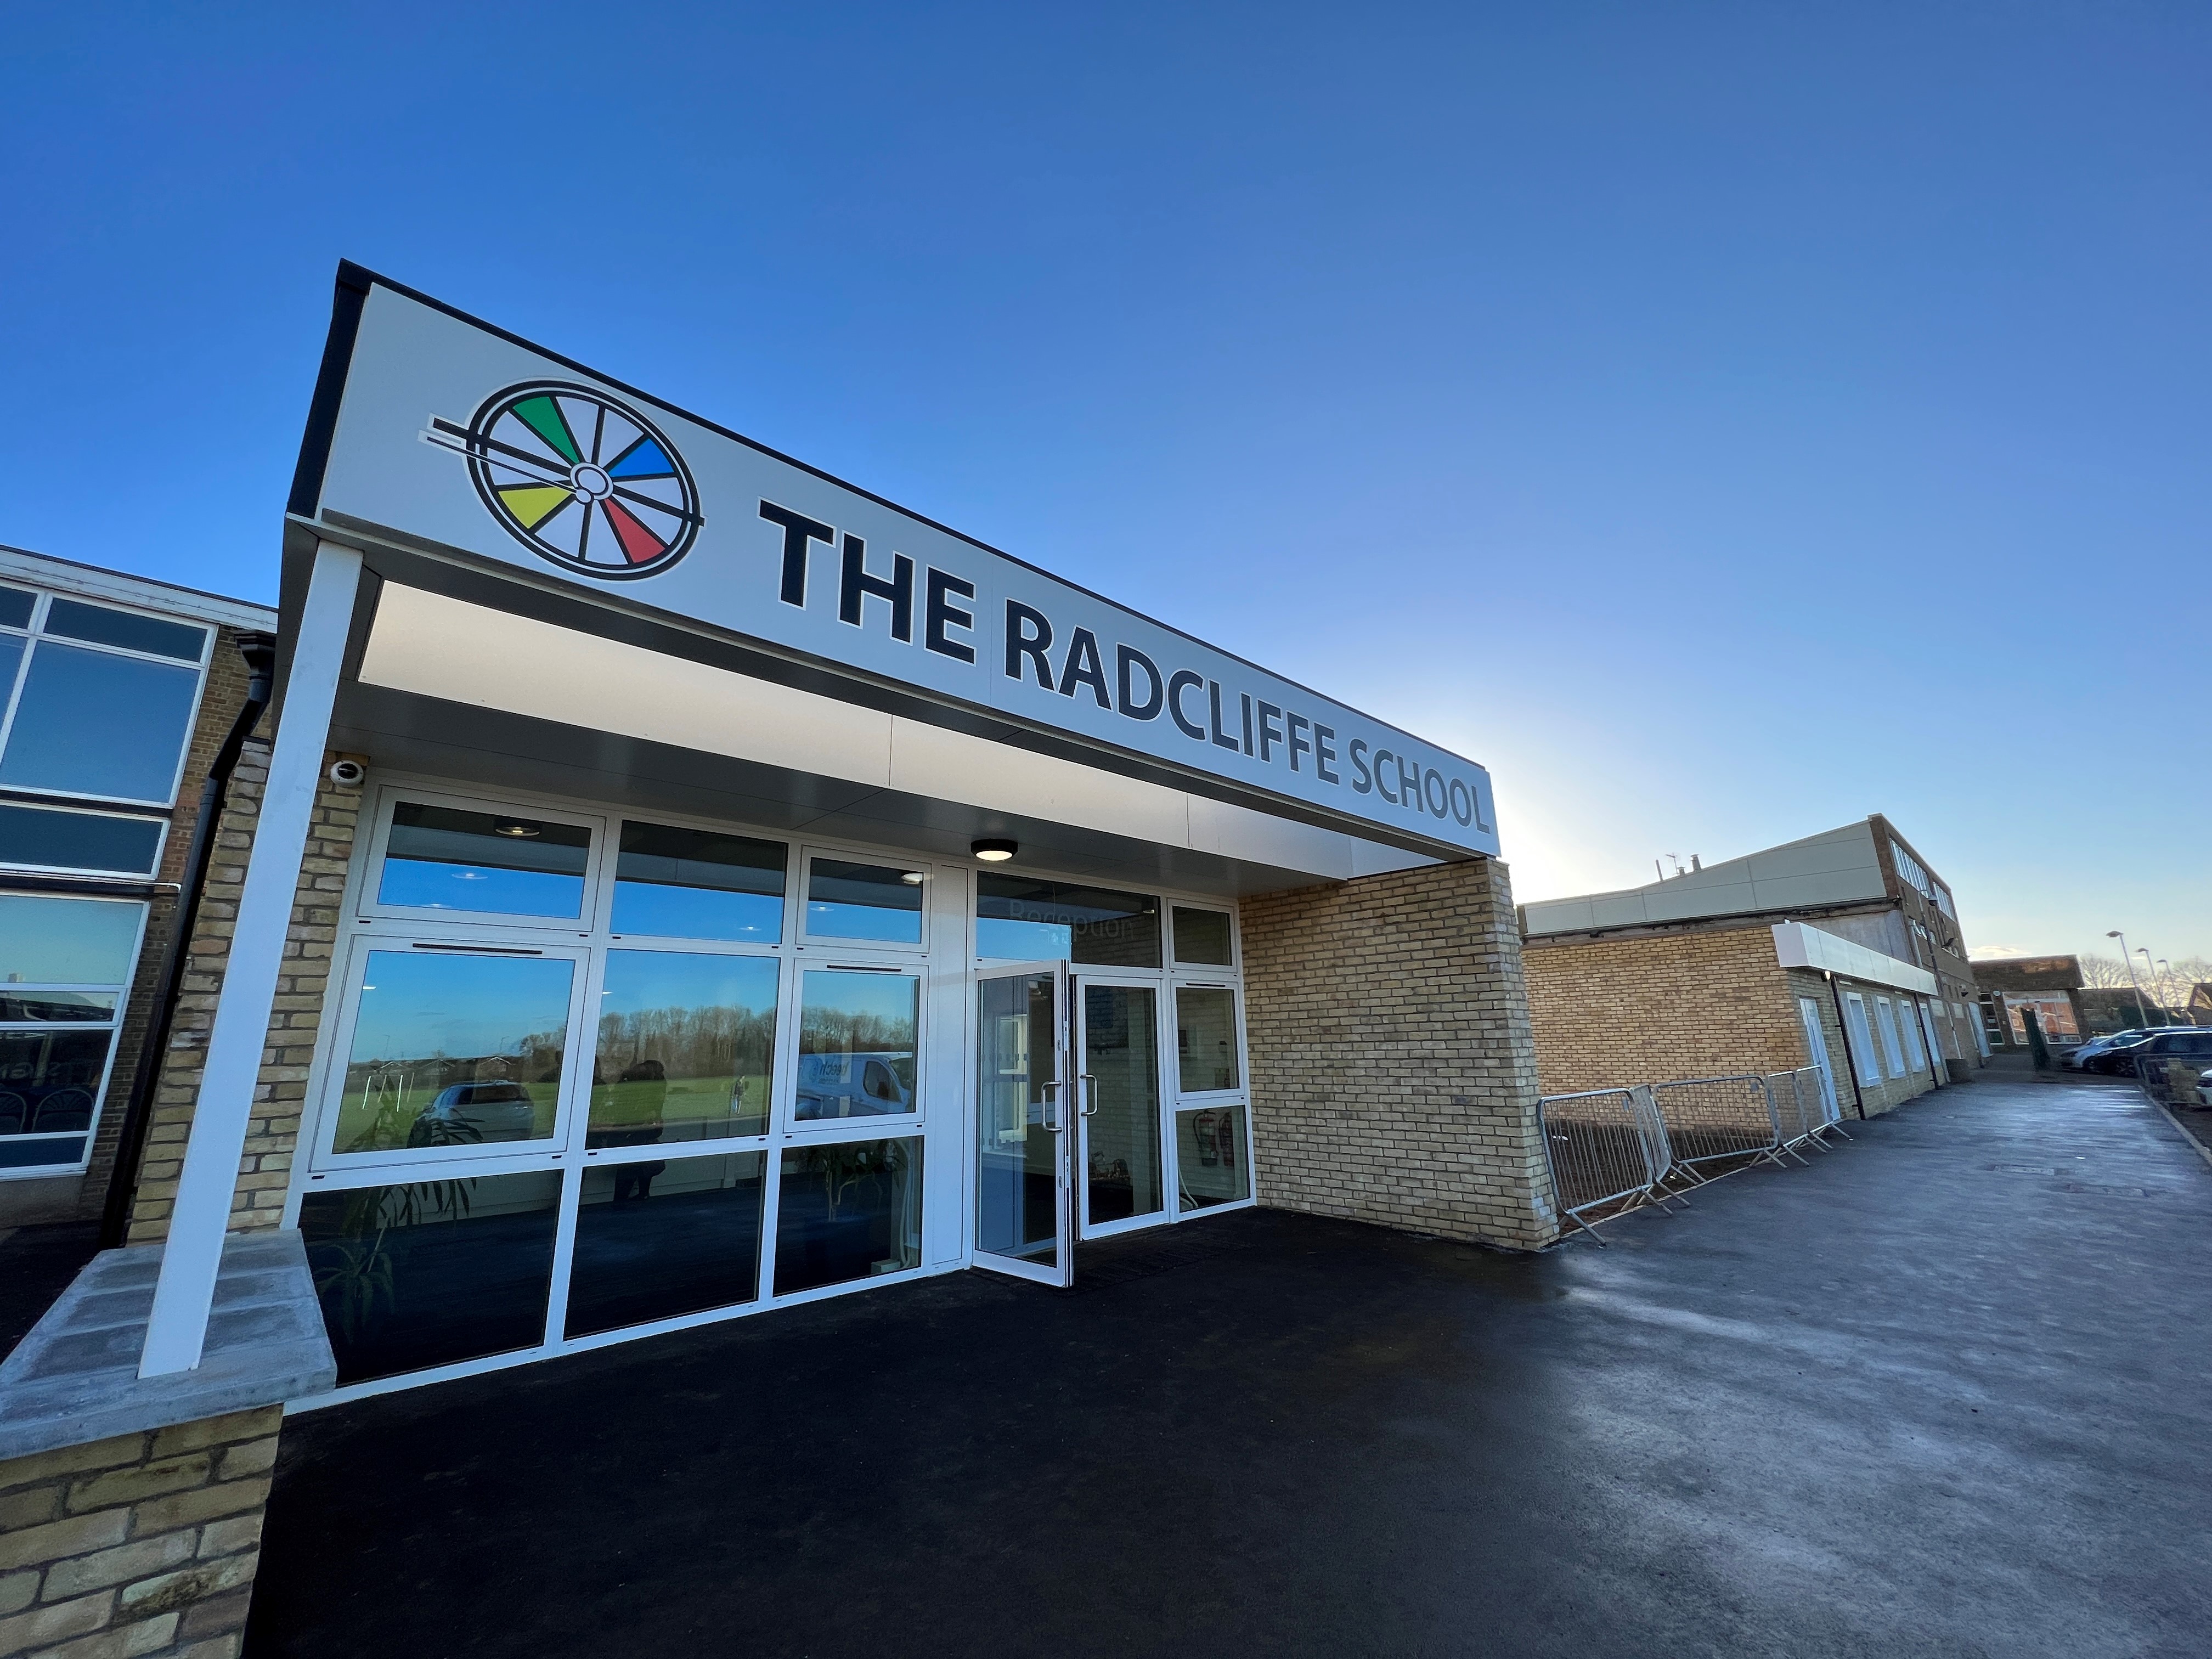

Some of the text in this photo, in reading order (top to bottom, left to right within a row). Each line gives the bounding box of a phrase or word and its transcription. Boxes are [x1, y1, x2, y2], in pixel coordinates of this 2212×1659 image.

[758, 497, 1490, 834] THE RADCLIFFE SCHOOL
